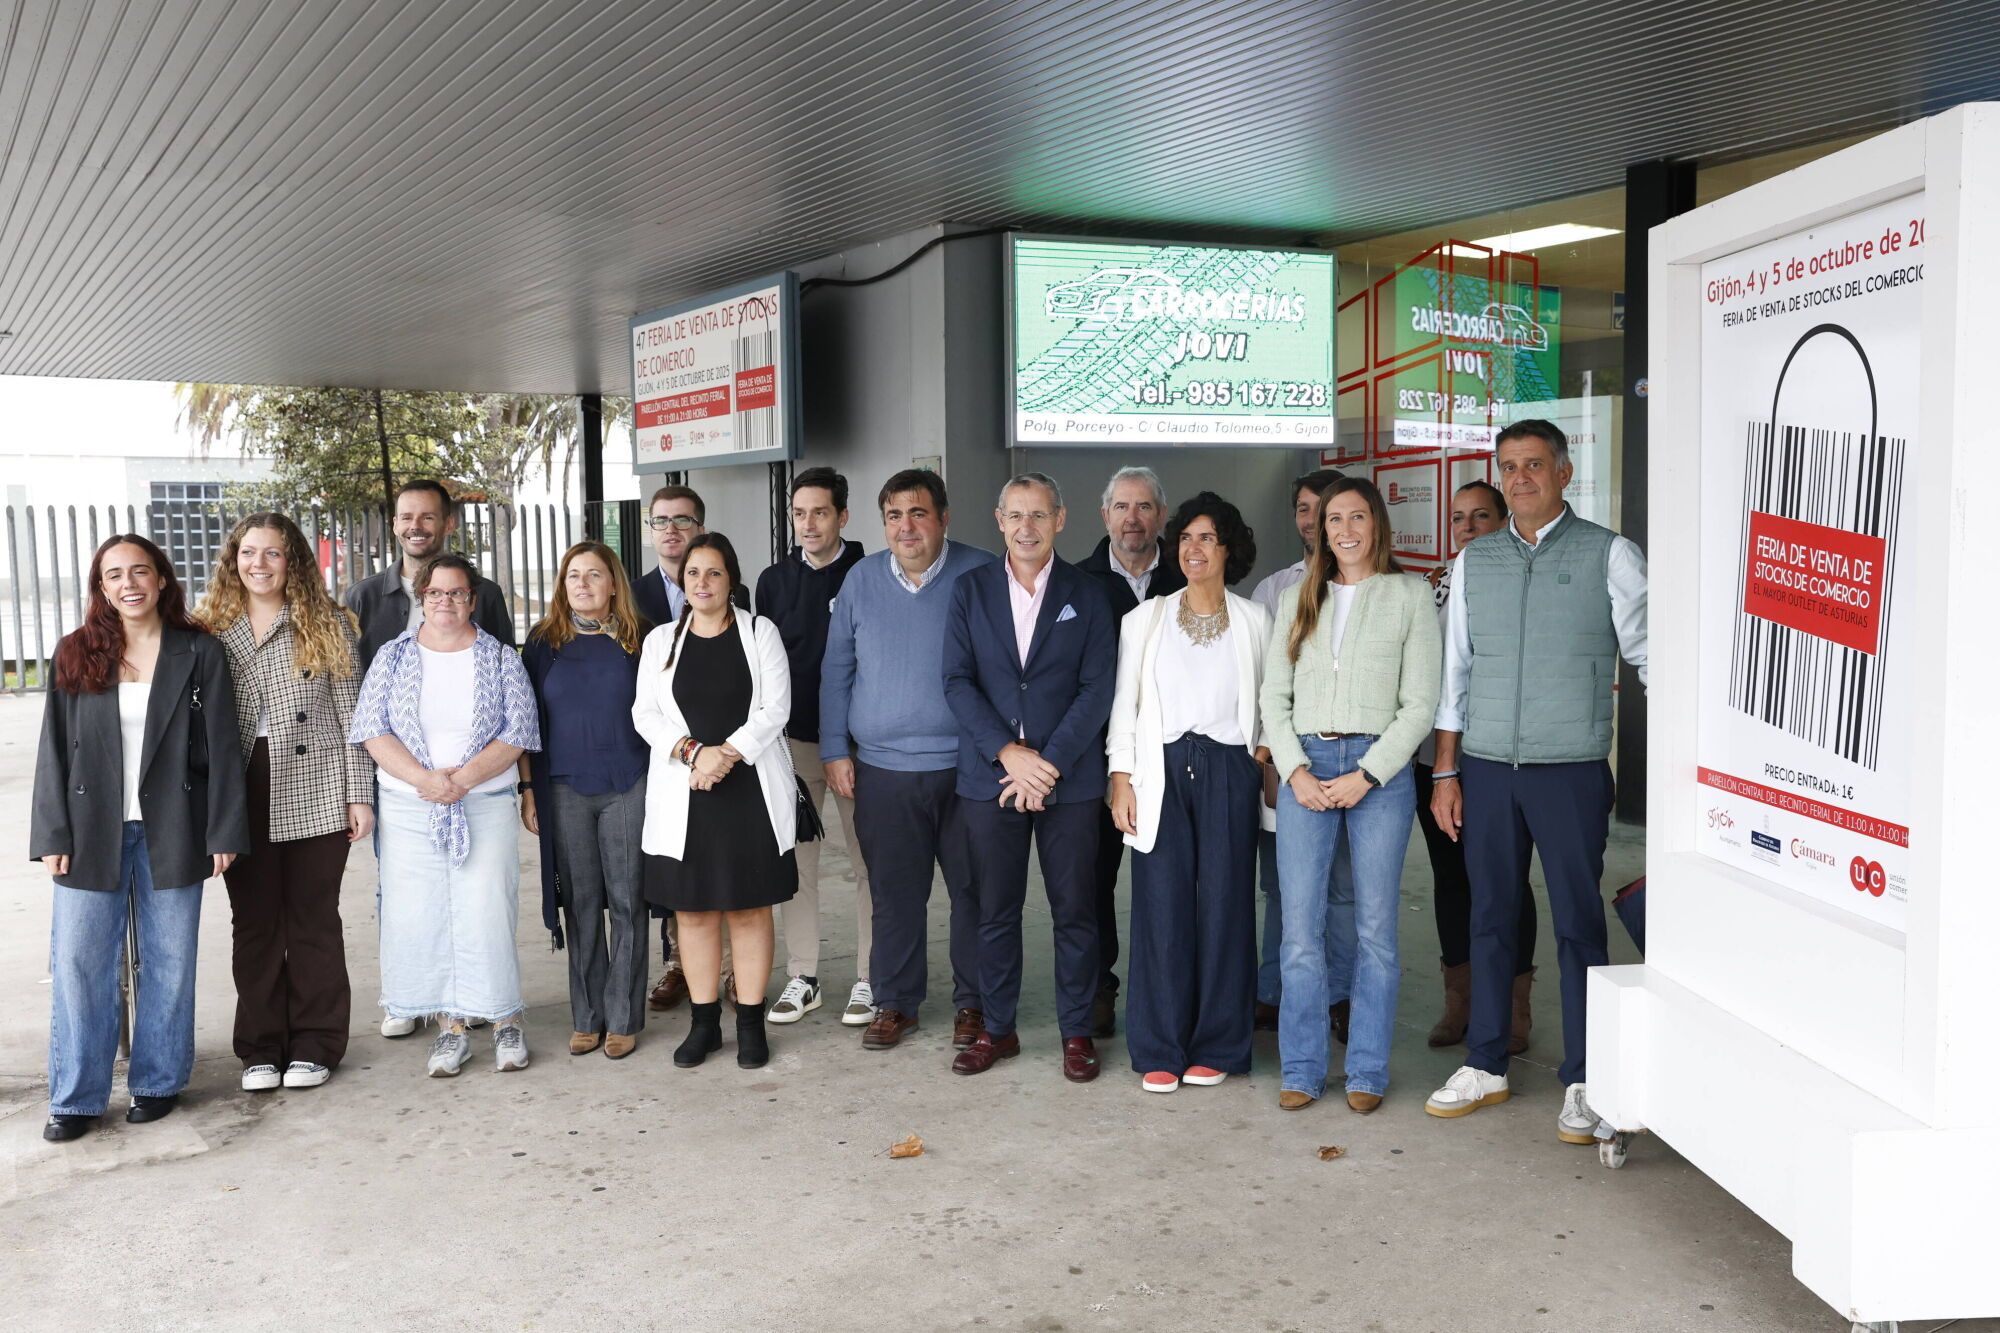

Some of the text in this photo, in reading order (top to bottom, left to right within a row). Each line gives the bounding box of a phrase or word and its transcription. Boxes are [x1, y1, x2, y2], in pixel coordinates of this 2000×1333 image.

[1760, 272, 1768, 294] y
[1773, 262, 1780, 286] 5
[1786, 256, 1804, 282] de
[1810, 240, 1874, 275] octubre
[1880, 227, 1901, 255] de
[1132, 287, 1306, 322] CARROCERÍAS
[1722, 311, 1744, 328] FERIA
[1746, 306, 1756, 322] DE
[1760, 300, 1786, 318] VENTA
[1789, 295, 1800, 312] DE
[1803, 285, 1842, 310] STOCKS
[1845, 280, 1862, 298] DEL
[636, 294, 778, 351] 47 FERIA DE VENTA DE STOCKS
[637, 347, 695, 378] DE COMERCIO
[1174, 332, 1248, 364] JOVI
[656, 381, 660, 390] 4
[661, 378, 665, 390] Y
[666, 378, 670, 390] 5
[671, 376, 678, 388] DE
[680, 371, 705, 387] OCTUBRE
[706, 368, 714, 381] DE
[716, 364, 730, 380] 2025
[1188, 381, 1231, 404] 985
[1238, 382, 1278, 406] 167
[1284, 384, 1326, 406] 228
[658, 414, 664, 424] DE
[664, 412, 676, 424] 11:00
[692, 407, 708, 418] HORAS
[662, 397, 680, 410] CENTRAL
[681, 396, 689, 407] DEL
[690, 392, 710, 406] RECINTO
[710, 390, 726, 402] FERIAL
[1066, 420, 1124, 435] Porceyo
[1157, 420, 1208, 433] Claudio
[1756, 535, 1872, 585] FERIA DE VENTA DE
[1754, 562, 1870, 608] STOCKS DE COMERCIO
[1754, 583, 1868, 628] EL MAYOR OUTLET DE ASTURIAS
[1765, 763, 1854, 800] PRECIO ENTRADA: 1€
[1708, 773, 1737, 792] PABELLÓN
[1738, 782, 1764, 800] CENTRAL
[1766, 791, 1778, 804] DEL
[1780, 794, 1808, 814] RECINTO
[1810, 804, 1832, 821] FERIAL
[1834, 811, 1843, 824] DE
[1868, 822, 1874, 834] A
[1878, 824, 1900, 842] 21:00
[1790, 838, 1836, 867] Cámara
